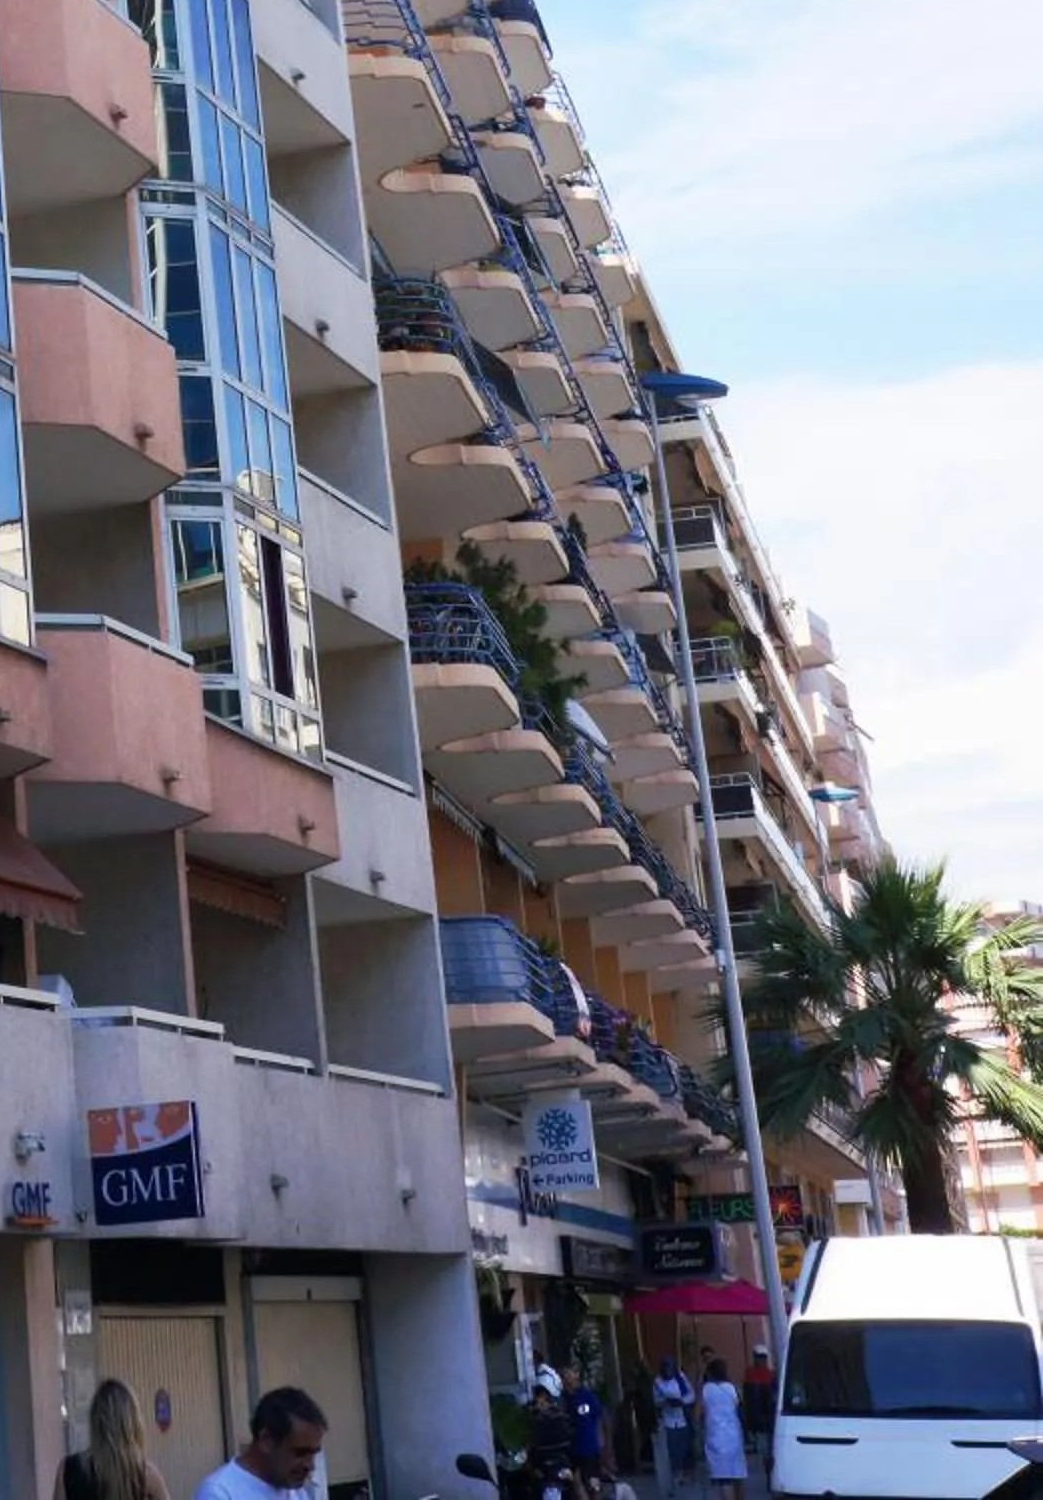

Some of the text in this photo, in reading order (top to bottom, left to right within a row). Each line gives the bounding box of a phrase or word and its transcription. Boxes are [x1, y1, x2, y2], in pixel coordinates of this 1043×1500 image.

[531, 1149, 592, 1167] picard
[101, 1163, 188, 1207] GMF
[546, 1172, 594, 1186] Parking
[12, 1182, 51, 1217] GMF
